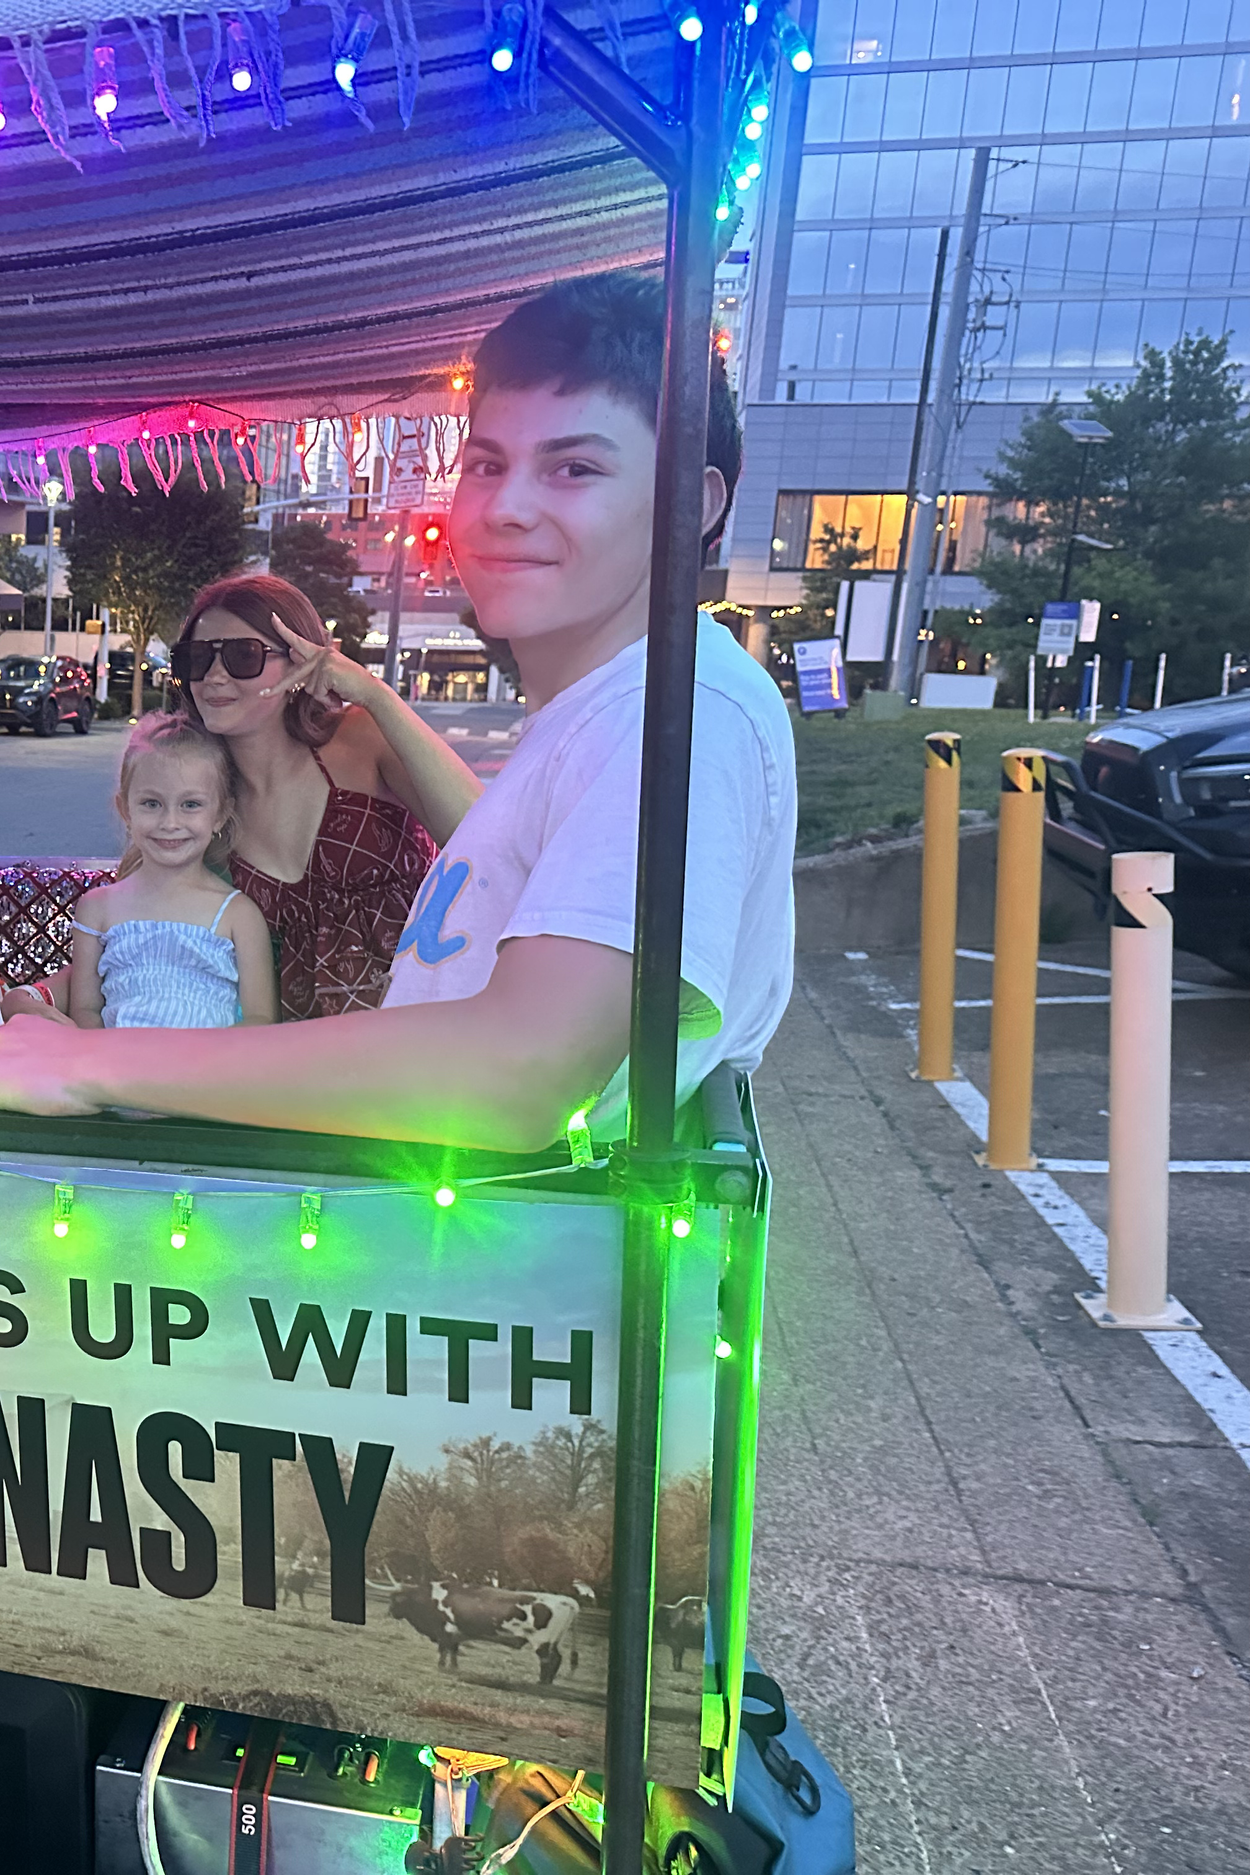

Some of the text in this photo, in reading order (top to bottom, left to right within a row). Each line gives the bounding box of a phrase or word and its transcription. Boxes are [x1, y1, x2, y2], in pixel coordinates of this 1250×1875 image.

[69, 1278, 211, 1367] UP
[248, 1297, 595, 1416] WITH
[241, 1803, 257, 1836] 500
